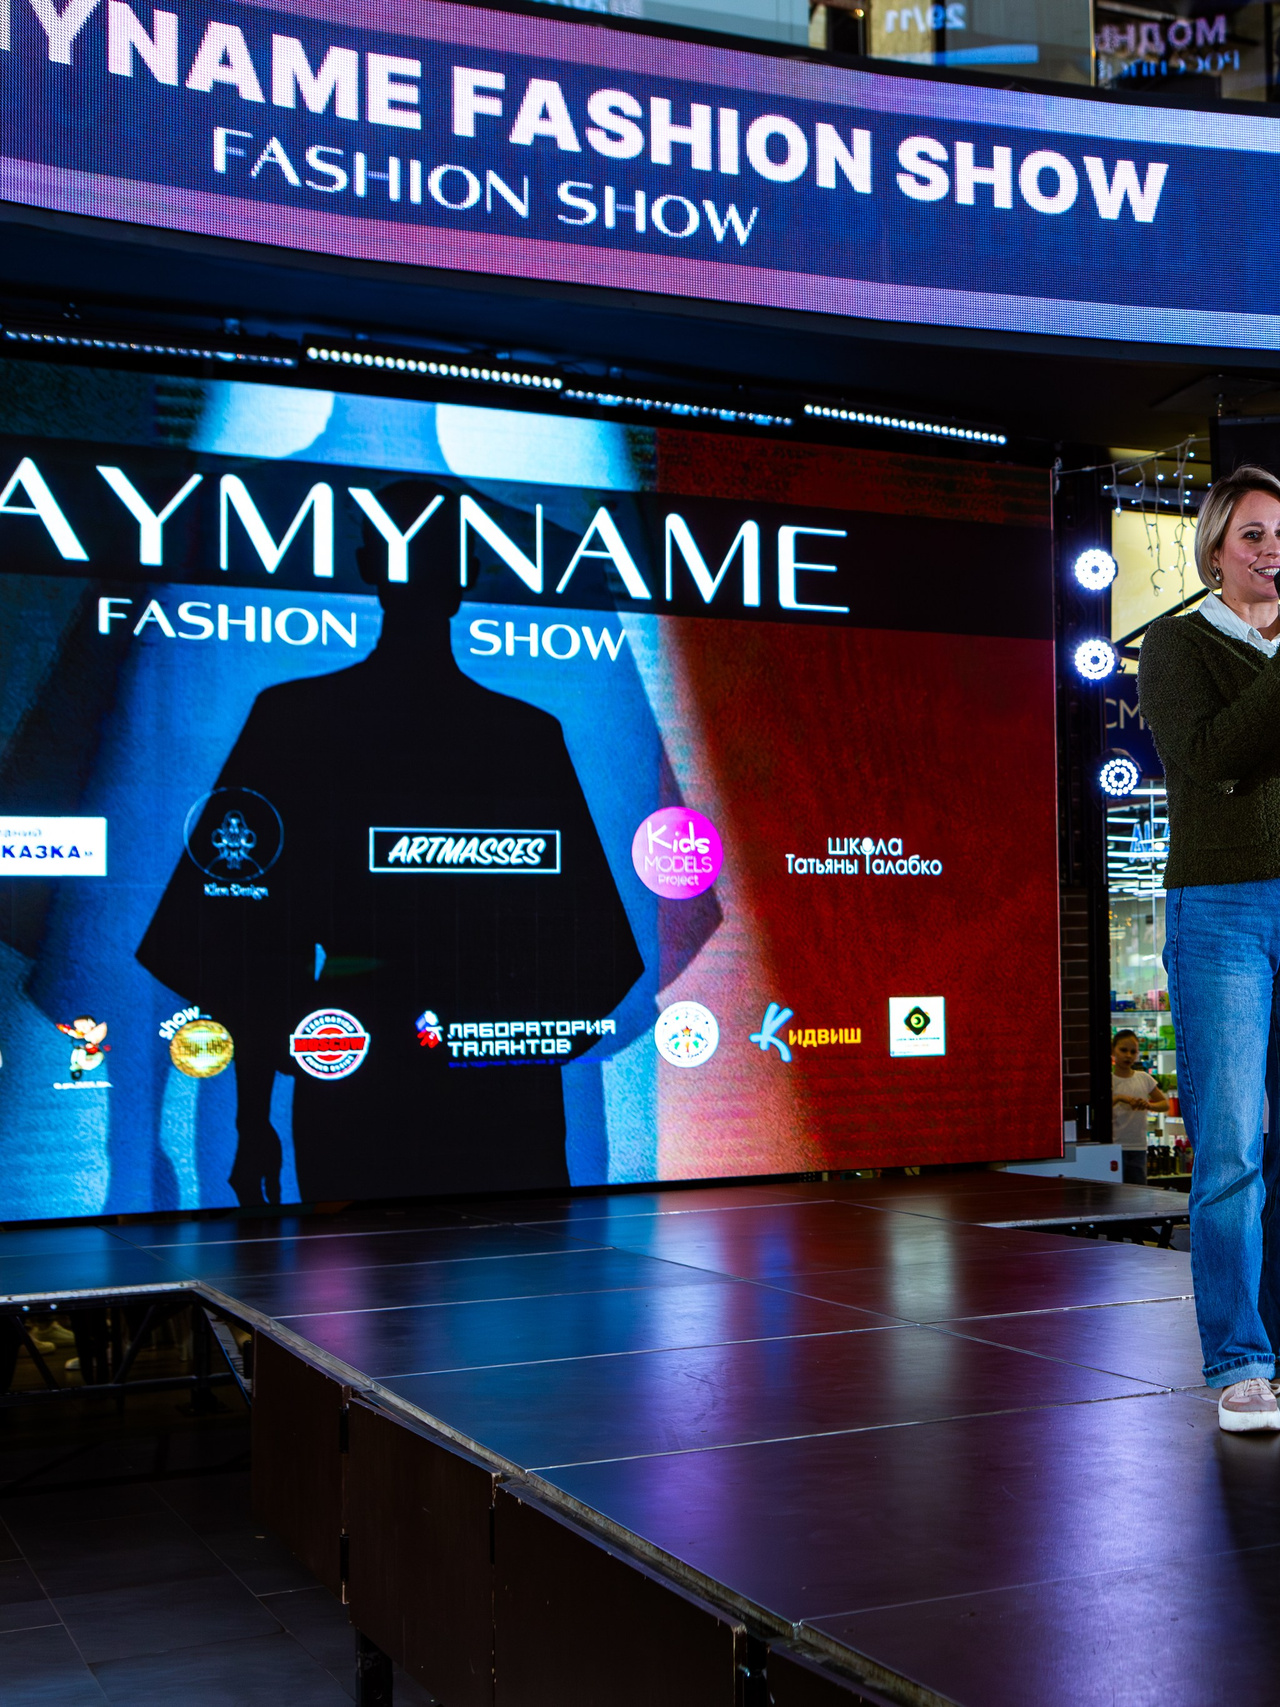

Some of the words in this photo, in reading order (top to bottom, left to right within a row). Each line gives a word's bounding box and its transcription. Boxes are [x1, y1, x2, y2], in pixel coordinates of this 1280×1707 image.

[451, 65, 872, 194] FASHION
[896, 135, 1169, 223] SHOW
[213, 127, 528, 218] FASHION
[557, 180, 759, 246] SHOW
[0, 456, 851, 613] AYMYNAME
[97, 596, 358, 648] FASHION
[469, 618, 626, 661] SHOW
[387, 836, 547, 865] ARTMASSES
[646, 820, 710, 855] Kids
[643, 855, 713, 873] MODELS
[785, 853, 859, 874] Татьяны
[447, 1019, 616, 1039] ЛАБОРАТОРИЯ
[294, 1037, 365, 1052] MOSCOW
[447, 1038, 571, 1057] ТАЛАНТОВ
